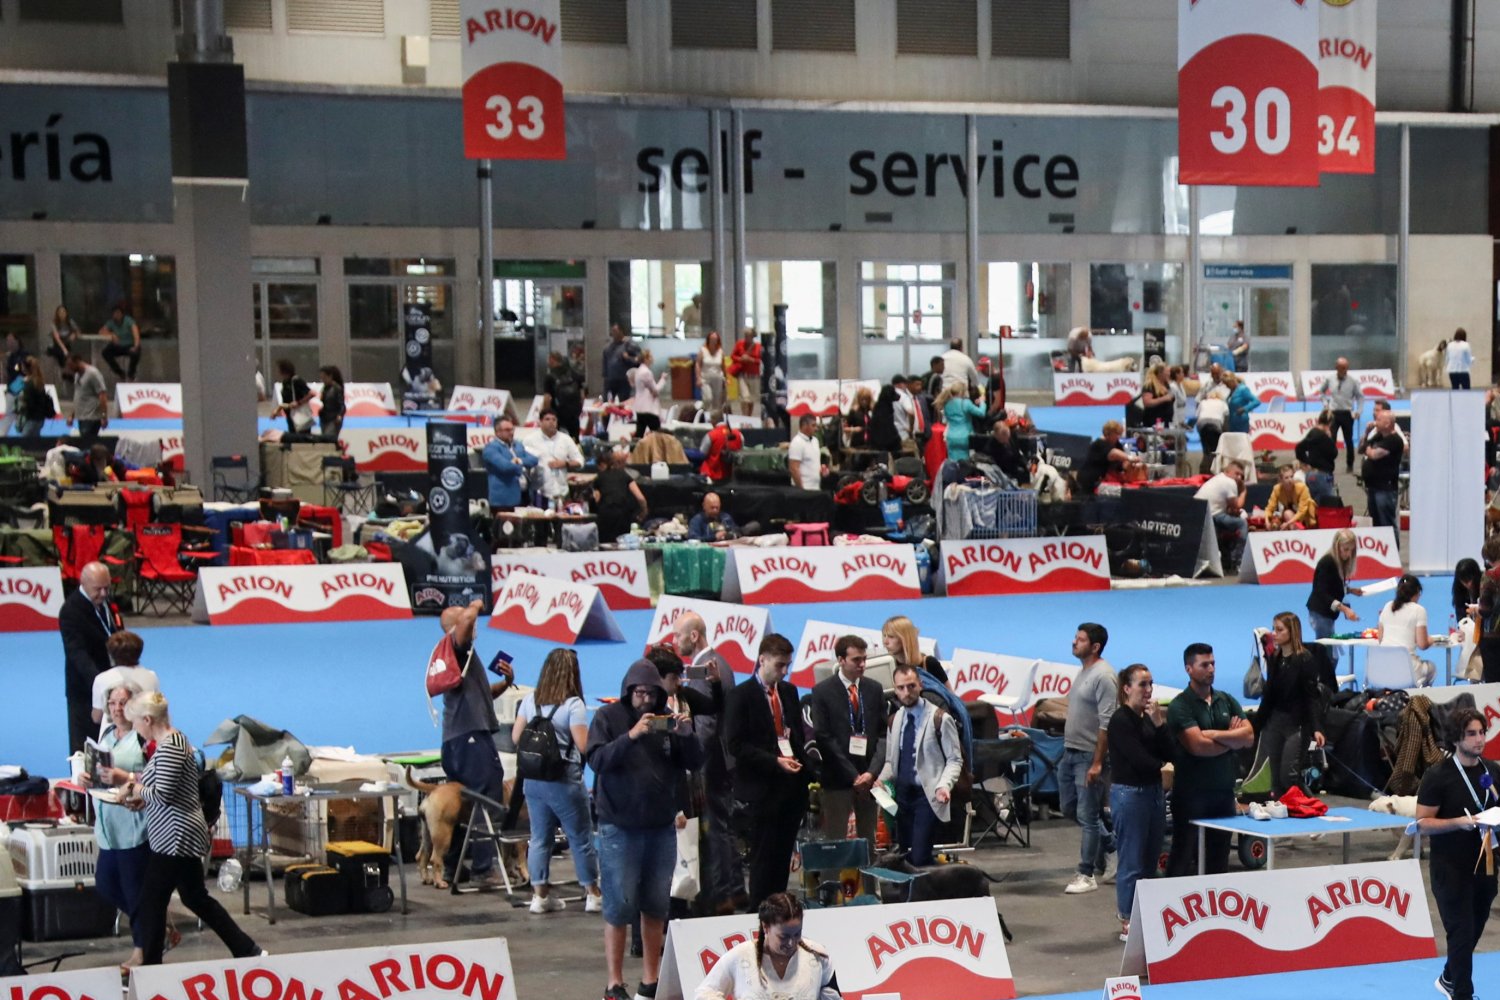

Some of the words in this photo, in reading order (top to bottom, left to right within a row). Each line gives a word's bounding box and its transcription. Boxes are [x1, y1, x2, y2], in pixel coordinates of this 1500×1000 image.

[465, 8, 557, 45] ARION
[1319, 37, 1373, 71] RION
[485, 95, 545, 140] 33
[1210, 85, 1291, 155] 30
[0, 113, 113, 183] ría
[1318, 115, 1361, 156] 34
[637, 130, 762, 194] self
[848, 139, 1080, 199] service
[127, 388, 171, 405] ARION
[1061, 378, 1094, 392] ARION
[1106, 377, 1141, 392] ARION
[1254, 377, 1289, 391] ARION
[1360, 375, 1388, 388] RION
[368, 434, 419, 454] ARION
[1051, 456, 1072, 468] TERO
[1142, 519, 1181, 537] ARTERO
[947, 544, 1022, 576] ARION
[1028, 541, 1103, 574] ARION
[1262, 539, 1317, 564] ARION
[1357, 535, 1389, 558] ION
[570, 561, 637, 585] ARION
[750, 556, 817, 582] ARION
[841, 553, 907, 579] ARION
[217, 575, 293, 602] ARION
[321, 572, 395, 599] ARION
[503, 581, 541, 609] ARION
[547, 590, 584, 618] ARION
[713, 615, 758, 646] ARION
[804, 633, 838, 660] ARI
[954, 662, 1009, 696] ARION
[1161, 888, 1270, 944] ARION
[1306, 876, 1411, 933] ARION
[865, 917, 986, 970] ARION
[1111, 982, 1138, 995] ARION
